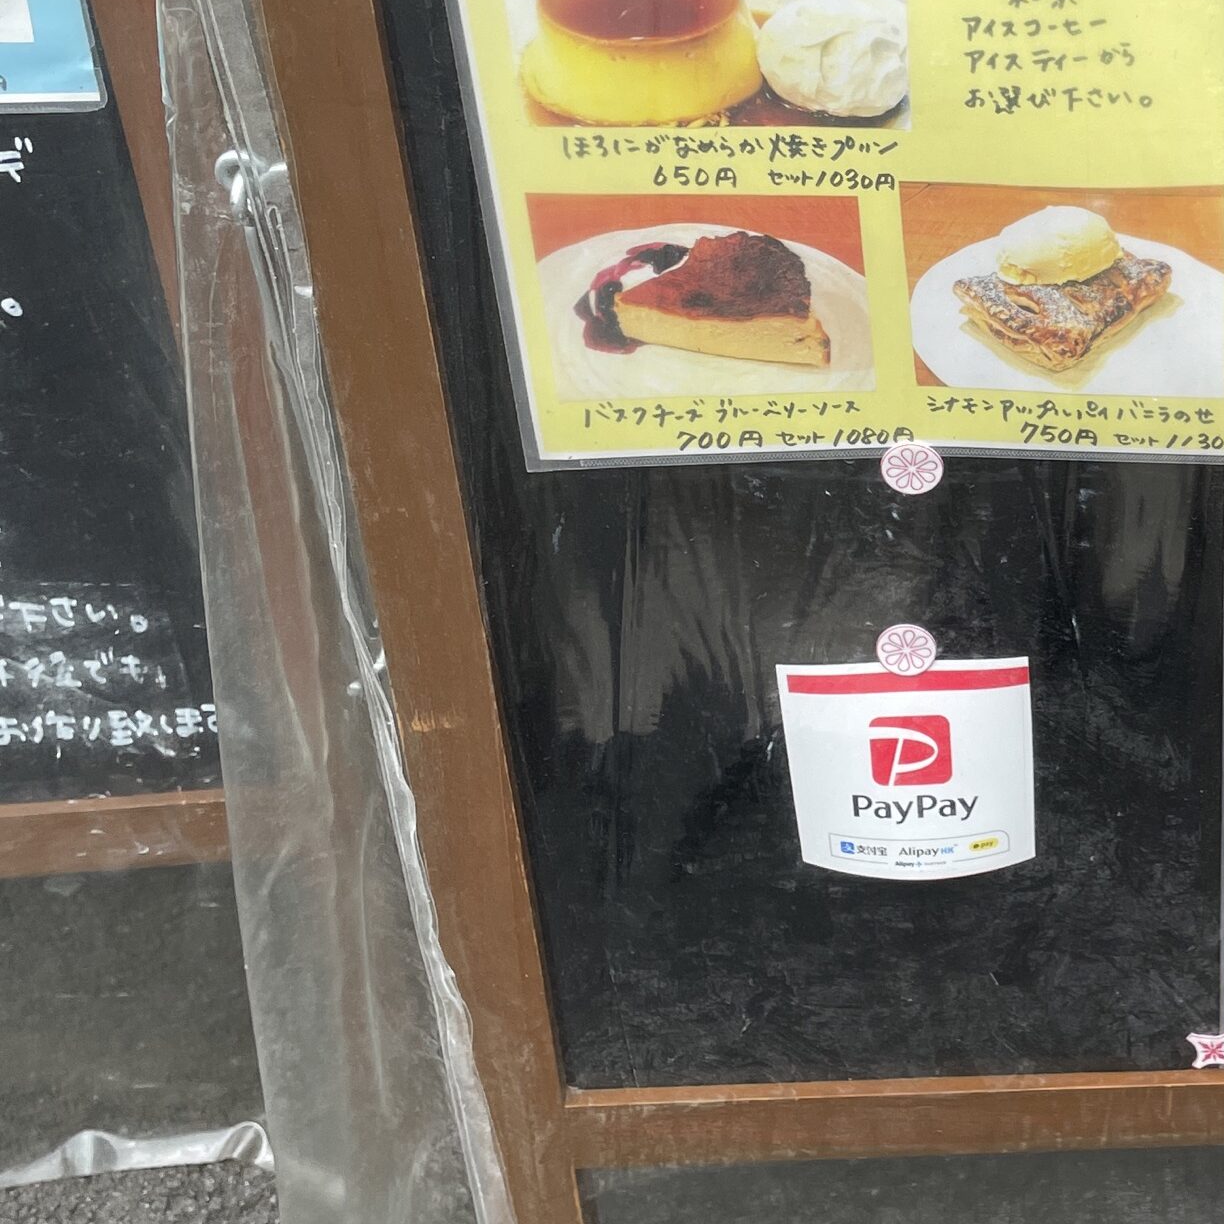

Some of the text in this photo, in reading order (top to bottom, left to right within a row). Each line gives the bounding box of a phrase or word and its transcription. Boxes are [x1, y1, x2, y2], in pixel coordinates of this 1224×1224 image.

[963, 84, 1154, 115] お選び下さい。
[652, 164, 739, 189] 650円
[676, 429, 764, 452] 700円
[1019, 421, 1098, 445] 750円
[851, 794, 980, 825] PayPay
